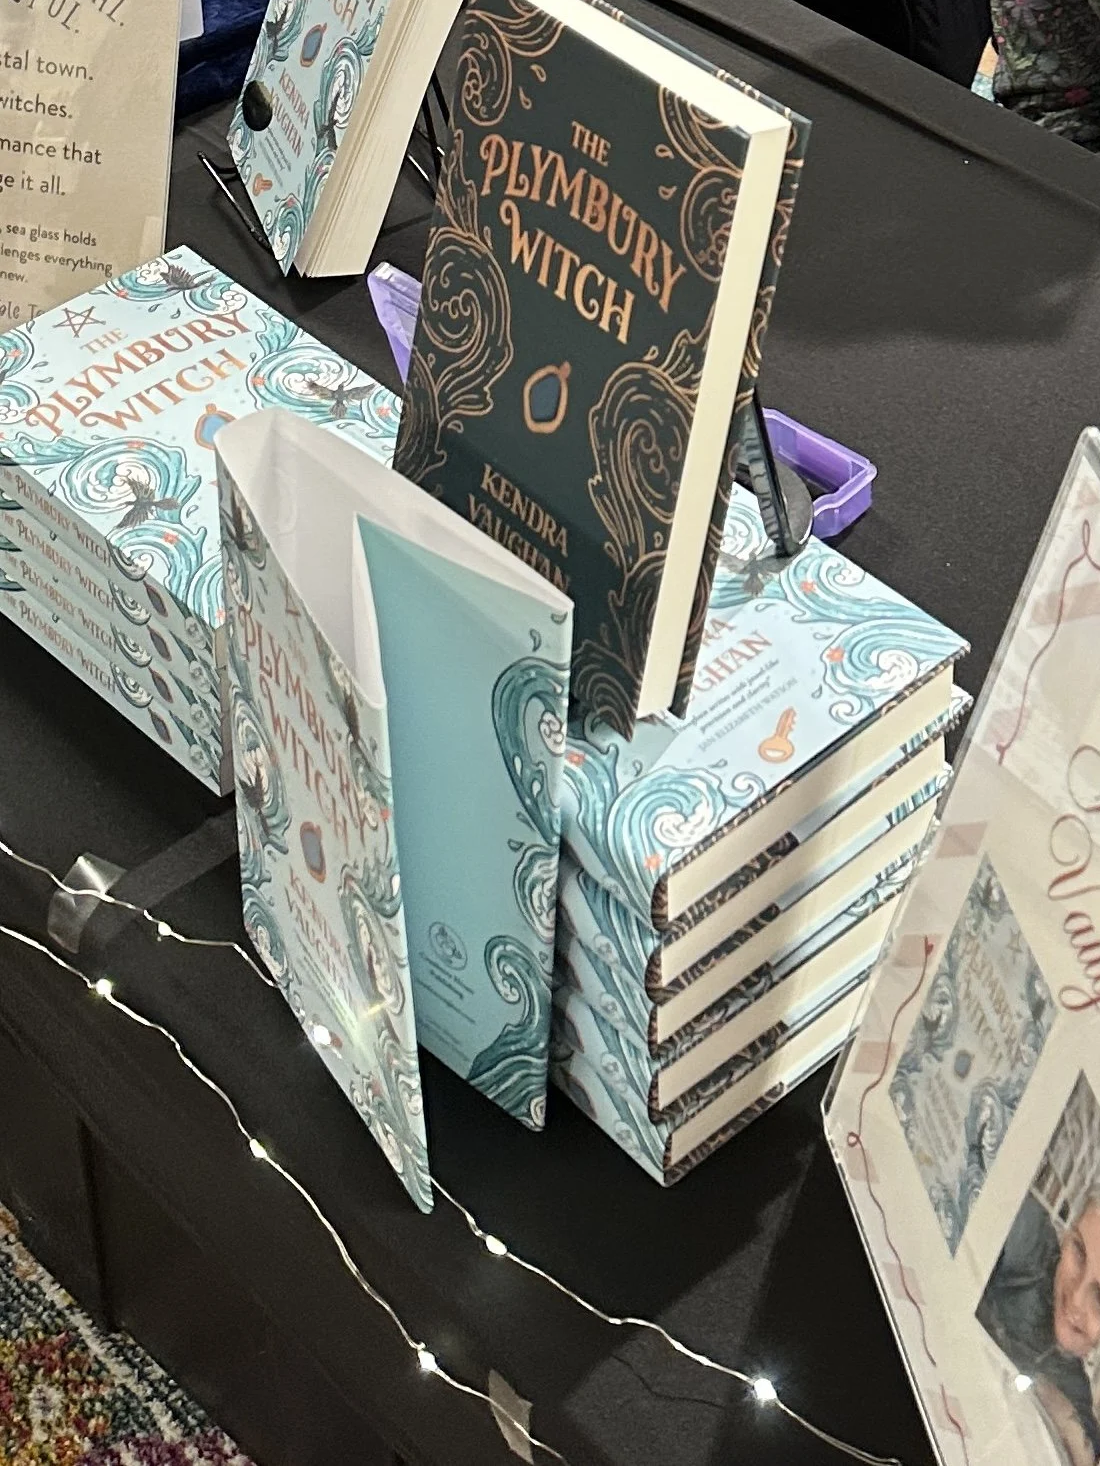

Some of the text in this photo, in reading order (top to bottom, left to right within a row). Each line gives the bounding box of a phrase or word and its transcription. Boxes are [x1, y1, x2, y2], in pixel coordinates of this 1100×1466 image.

[36, 55, 94, 81] town.
[278, 68, 312, 130] KENDRA
[21, 171, 34, 191] it
[39, 175, 66, 196] all.
[63, 142, 102, 165] that
[571, 120, 612, 167] THE
[6, 223, 97, 247] sea glass holds
[44, 253, 113, 278] everything
[479, 133, 688, 314] PLYMBURY
[499, 198, 635, 345] WITCH
[24, 310, 255, 437] PLYMBURY
[79, 326, 130, 356] THE
[79, 348, 249, 431] WITCH
[15, 474, 112, 568] PLYMBURY WITCH
[480, 462, 568, 558] KENDRA
[15, 519, 115, 612] PLYMBURY WITCH
[20, 560, 118, 653] PLYMBURY WITCH
[19, 599, 116, 694] PLYMBURY WITCH
[259, 670, 349, 859] WITCH
